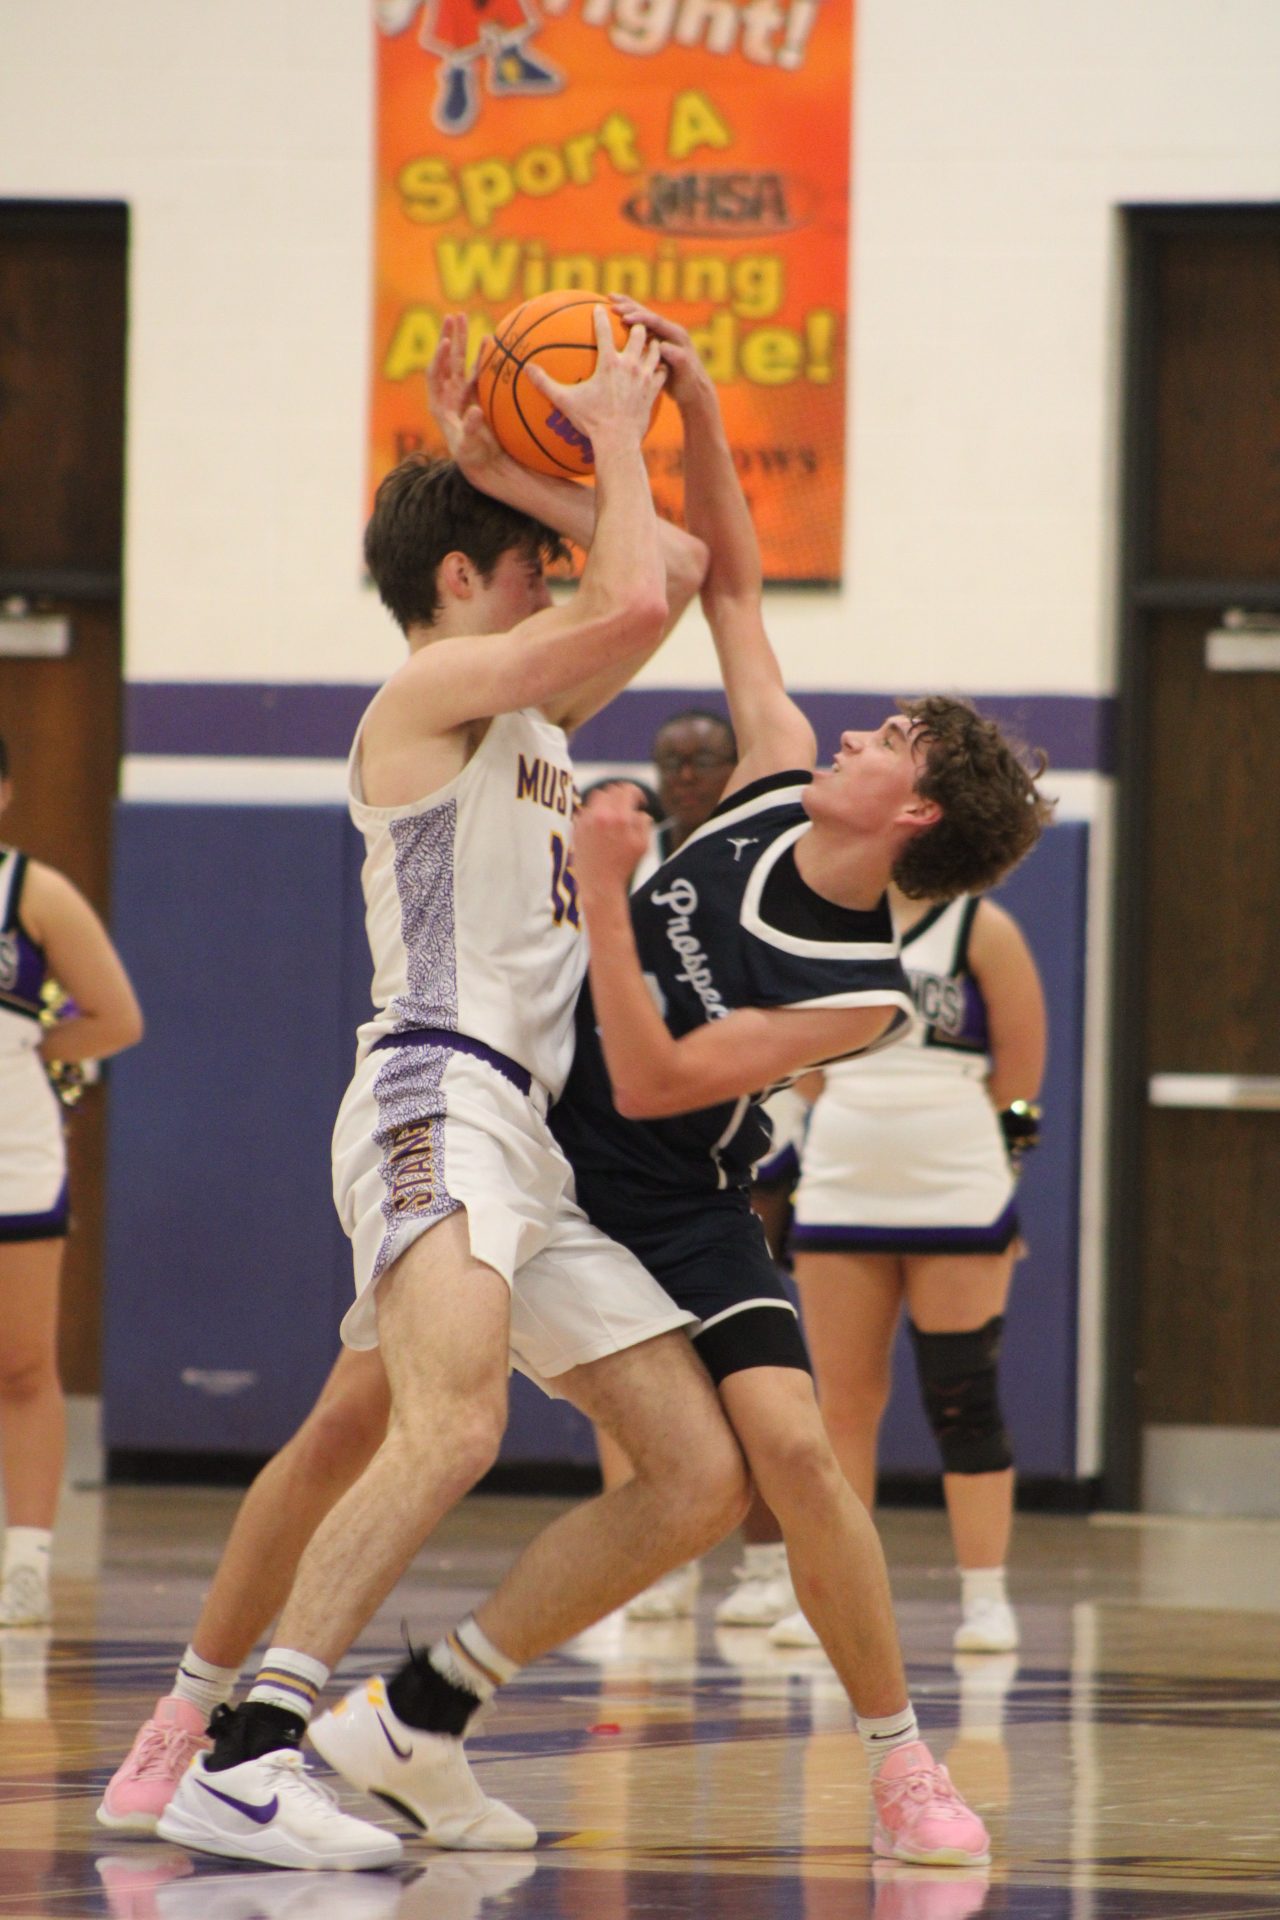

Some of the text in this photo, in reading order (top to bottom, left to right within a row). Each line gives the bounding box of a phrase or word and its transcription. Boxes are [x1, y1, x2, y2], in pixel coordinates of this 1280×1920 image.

[398, 89, 733, 229] Sport A
[435, 237, 784, 320] Winning
